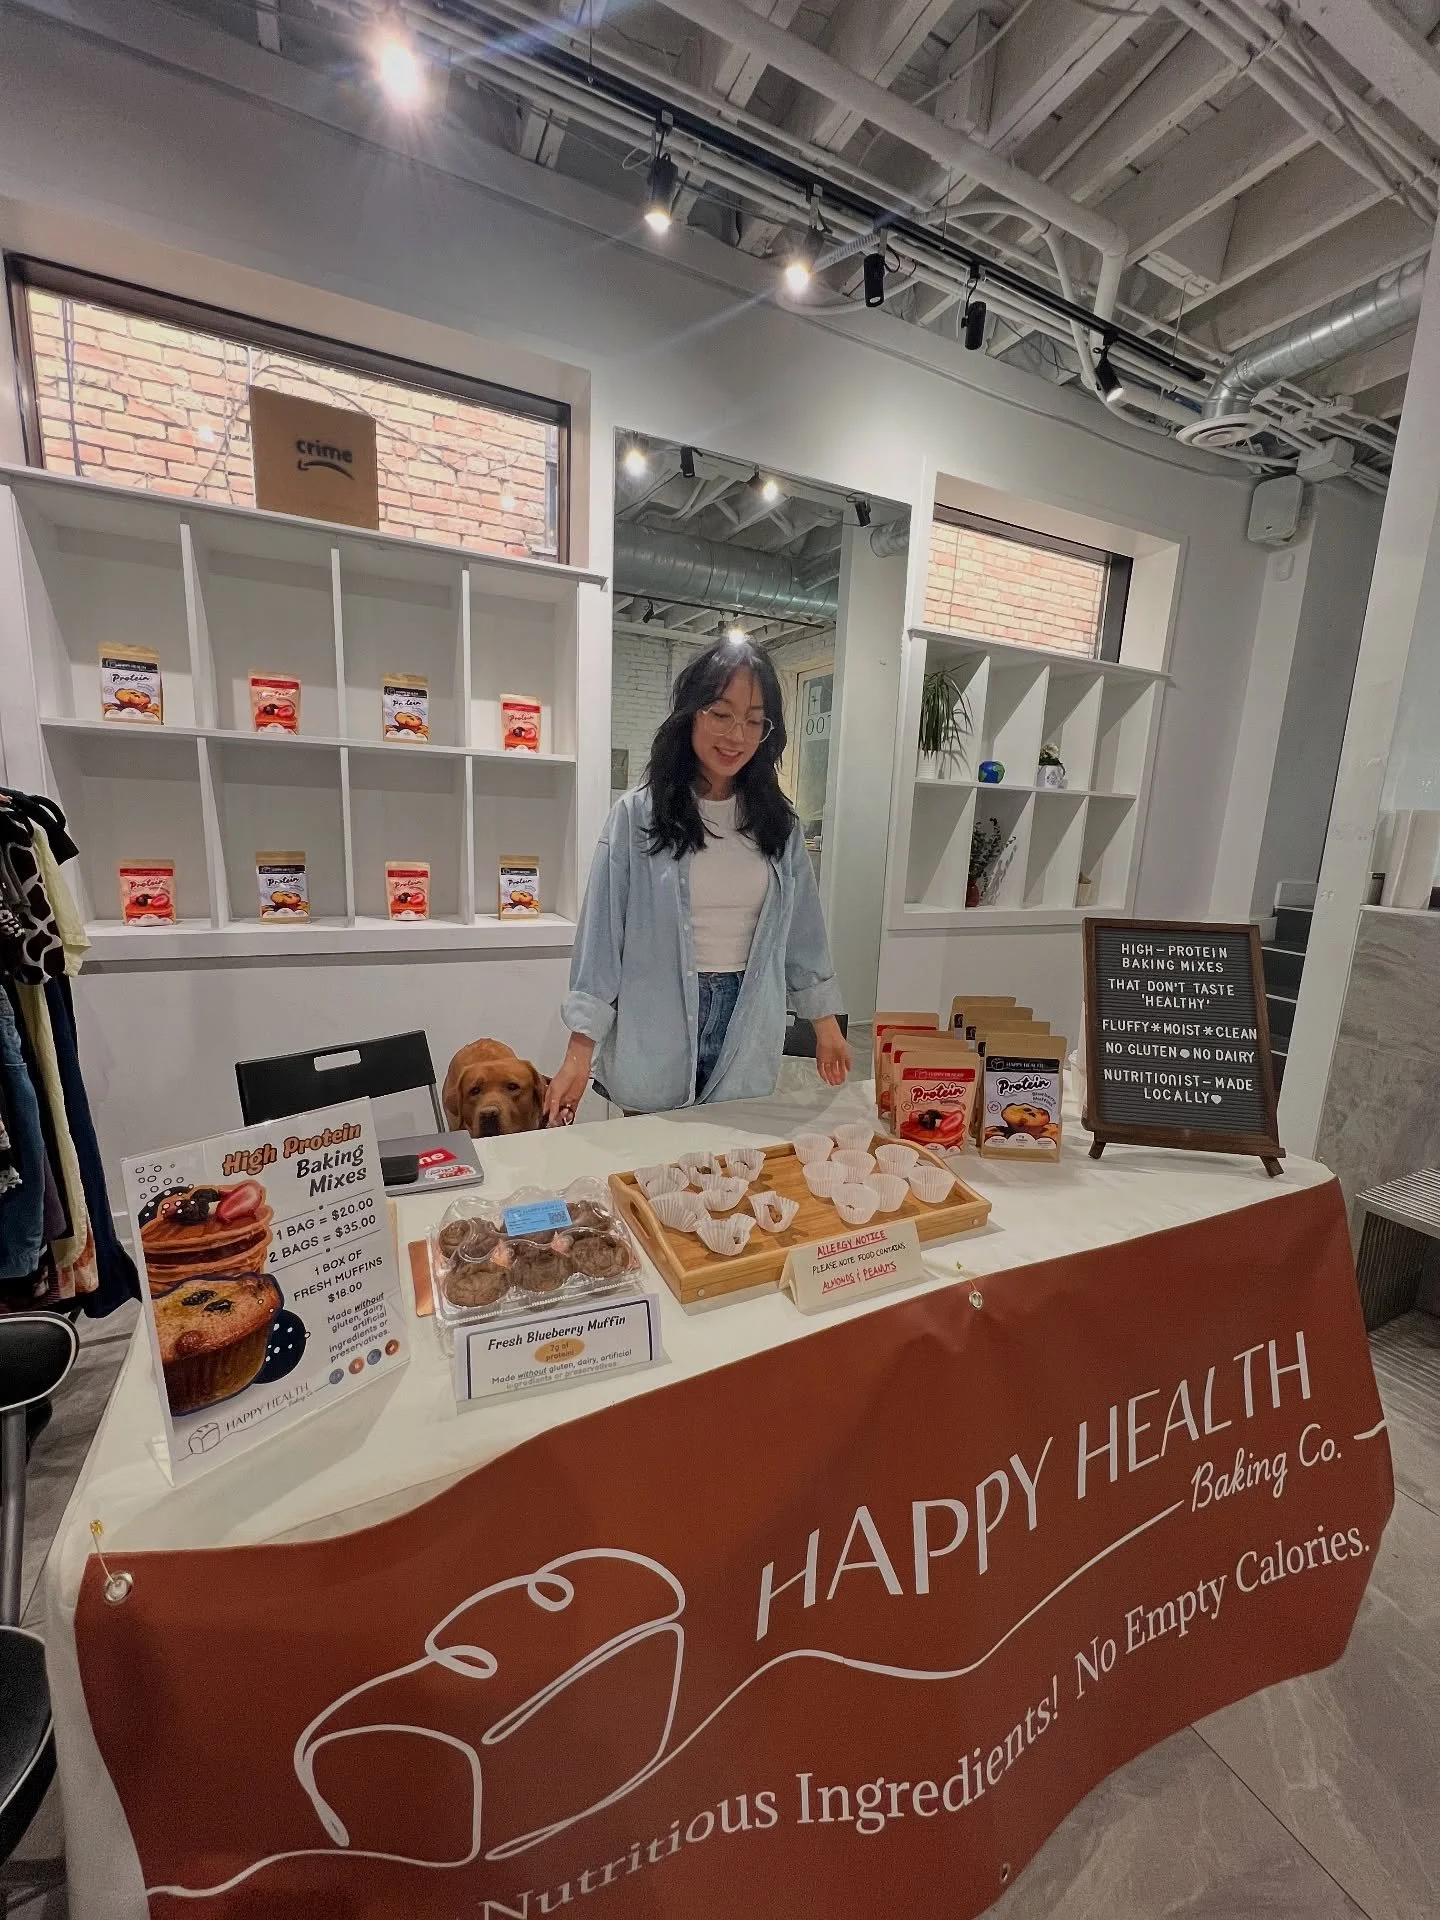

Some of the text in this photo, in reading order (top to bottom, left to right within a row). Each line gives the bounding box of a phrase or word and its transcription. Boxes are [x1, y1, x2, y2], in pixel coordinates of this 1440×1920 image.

[295, 439, 353, 463] crime
[111, 673, 151, 684] Protein
[129, 877, 165, 890] Protein
[1122, 957, 1224, 973] BAKING MIXES
[1108, 978, 1235, 996] THAT DON'T TASTE
[1141, 993, 1210, 1010] 'HEALTHY'
[1105, 1041, 1255, 1063] NO GLUTEN NO DAIRY
[912, 1083, 966, 1102] Protein
[997, 1075, 1051, 1095] Protein
[1143, 1087, 1210, 1104] LOCALLY
[222, 1123, 361, 1176] High Protein
[296, 1144, 363, 1178] Baking
[309, 1167, 366, 1197] Mixes
[277, 1230, 282, 1240] 1
[287, 1219, 315, 1237] BAG
[331, 1198, 373, 1221] $20.00
[269, 1251, 278, 1263] 2
[281, 1236, 319, 1258] BAGS
[335, 1214, 376, 1238] $35.00
[816, 1230, 886, 1257] ALLERGY NOTICE
[315, 1249, 362, 1276] 1 BOX OF
[812, 1242, 906, 1275] PLEASE NOTE FOOD CONTAINS
[294, 1256, 383, 1301] FRESH MUFFINS
[823, 1272, 855, 1290] ALMONDS
[863, 1261, 897, 1278] PEANUTS
[328, 1281, 363, 1303] $18.00
[327, 1292, 385, 1323] Made without
[352, 1310, 387, 1331] artificial
[329, 1319, 388, 1353] ingredients or
[331, 1314, 362, 1333] gluten,
[488, 1315, 626, 1350] Fresh Blueberry Muffin
[330, 1329, 390, 1363] preservatives.
[550, 1344, 560, 1352] 7g
[492, 1349, 632, 1385] Made without gluten, dairy, artificial
[554, 1372, 563, 1380] or
[226, 1382, 310, 1432] HAPPY HEALTH
[1190, 1423, 1343, 1512] Baking Co.
[755, 1331, 1312, 1641] HAPPY HEALTH
[478, 1524, 1370, 1920] Nutritious Ingredients! No Empty Calories.
